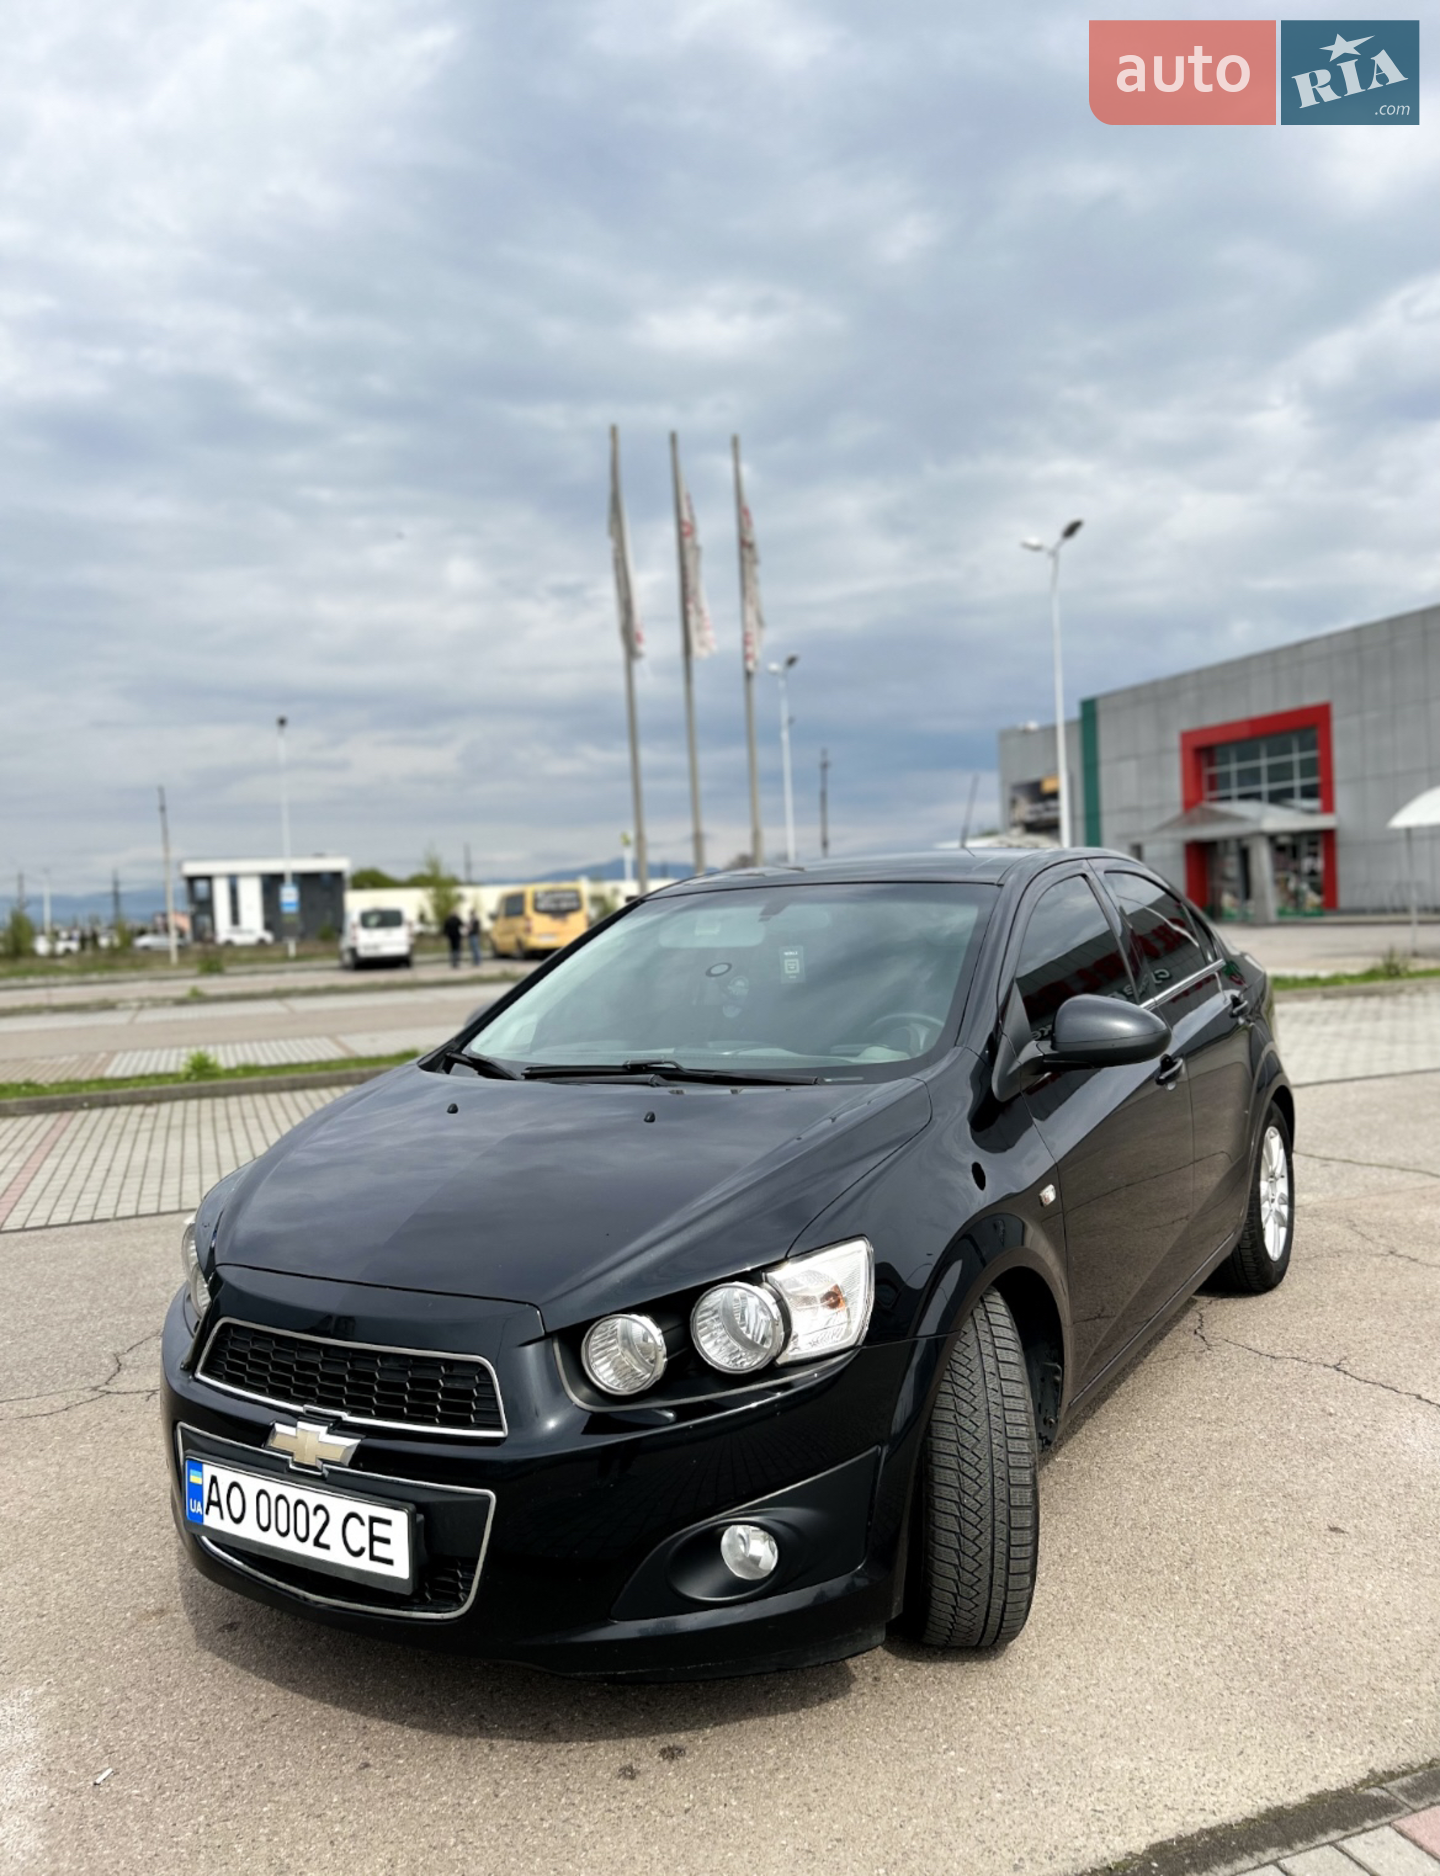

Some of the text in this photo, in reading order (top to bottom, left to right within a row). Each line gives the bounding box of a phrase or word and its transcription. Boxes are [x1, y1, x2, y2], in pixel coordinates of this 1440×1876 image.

[189, 1498, 203, 1516] UA
[205, 1474, 395, 1567] AO 0002 CE
